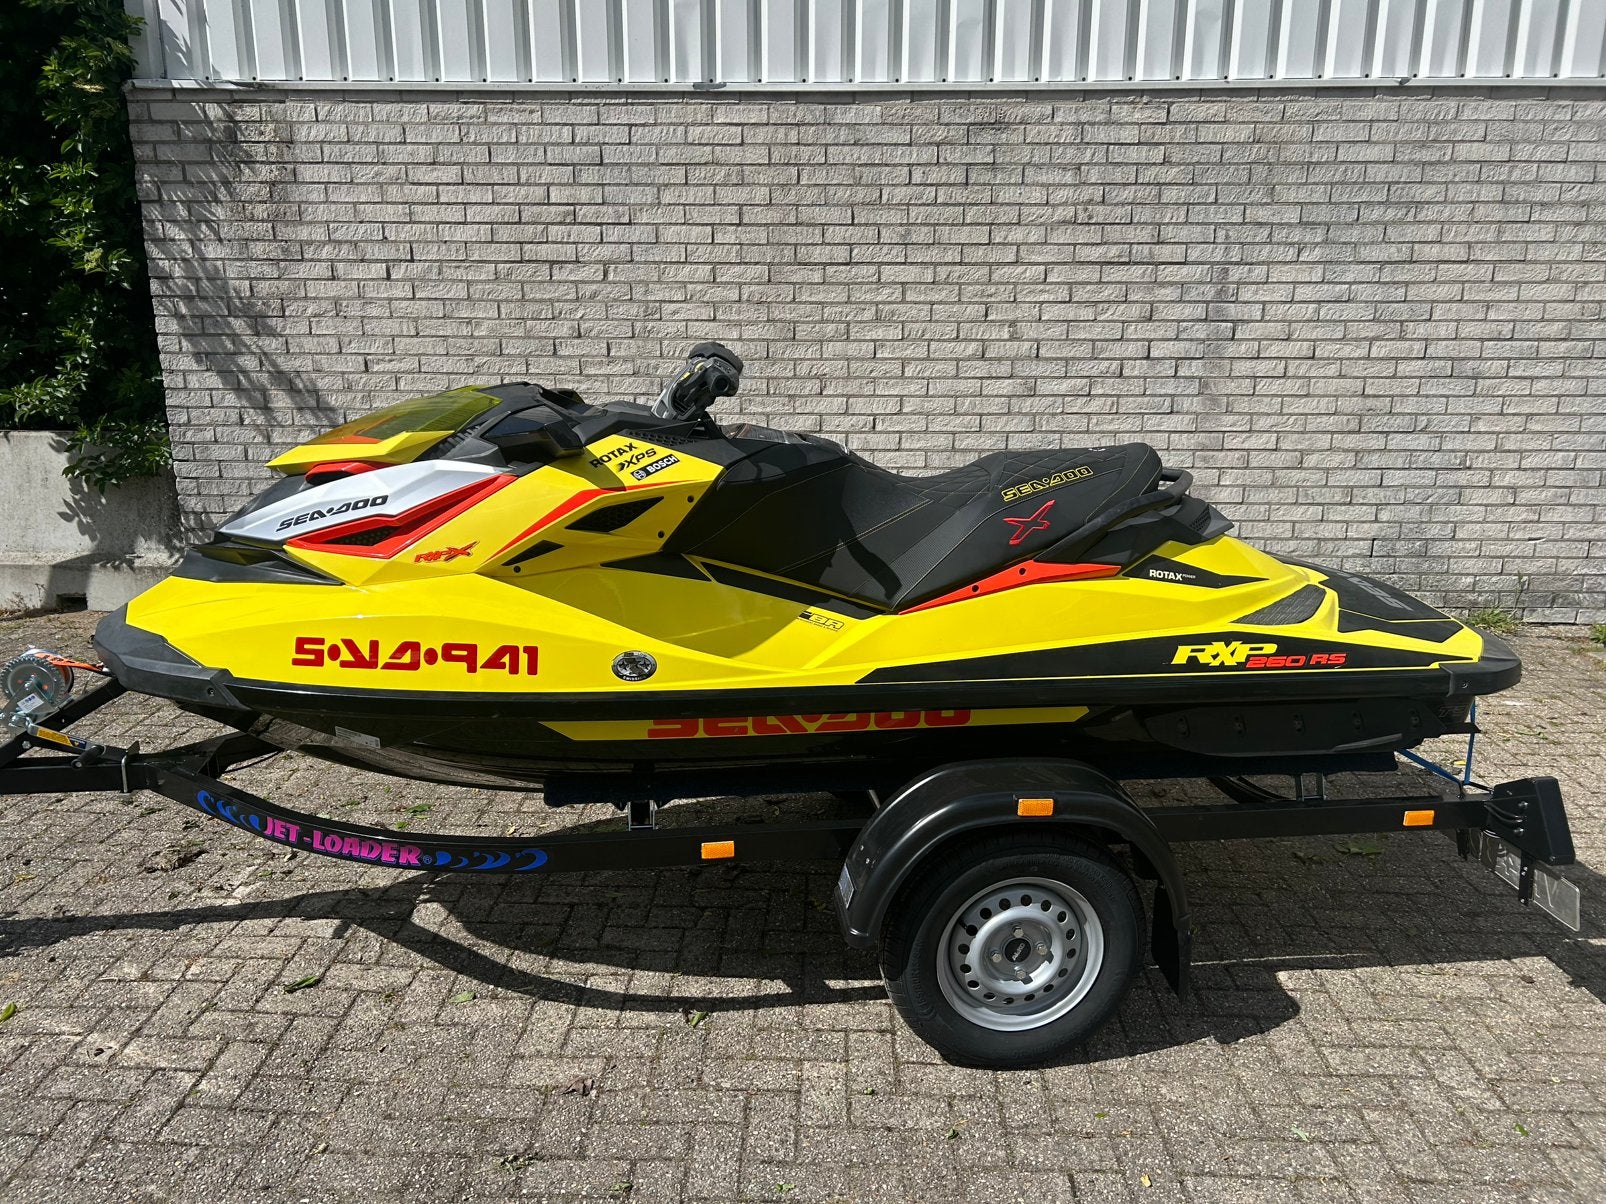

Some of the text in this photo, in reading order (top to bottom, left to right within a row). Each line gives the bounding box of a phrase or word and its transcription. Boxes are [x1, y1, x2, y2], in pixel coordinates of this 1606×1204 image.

[589, 442, 638, 468] ROTAX
[618, 448, 657, 472] XPS
[646, 455, 678, 473] BOSCH
[1149, 569, 1182, 581] ROTAX
[1171, 640, 1347, 668] RXP 260 RS
